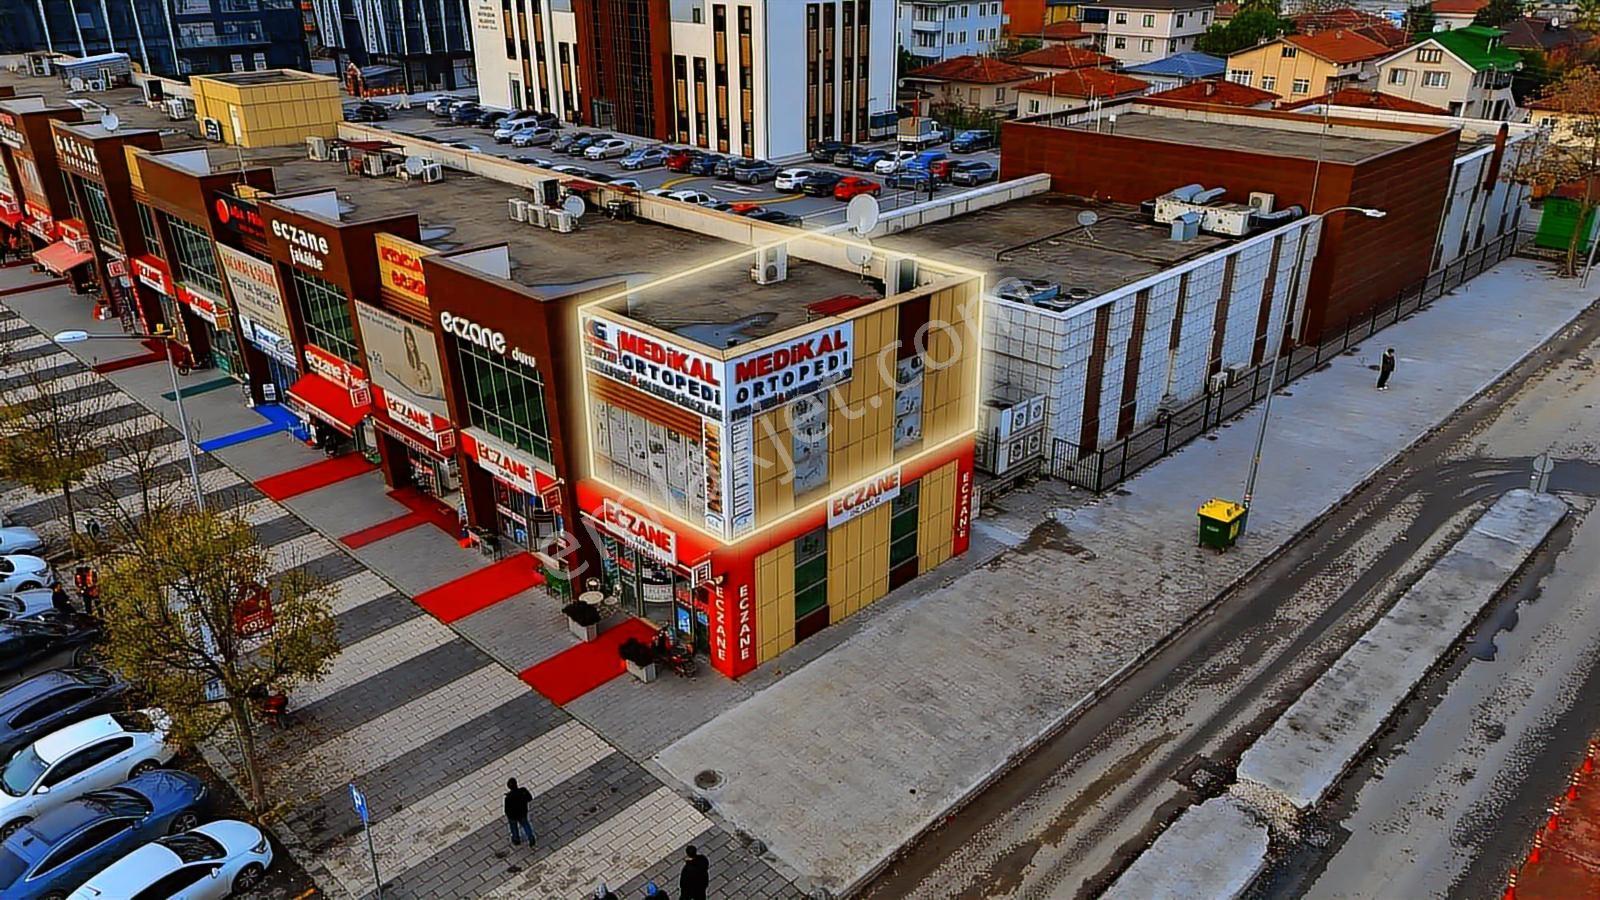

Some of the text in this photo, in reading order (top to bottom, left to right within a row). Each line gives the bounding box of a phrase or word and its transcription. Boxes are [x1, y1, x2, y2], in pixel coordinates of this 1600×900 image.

[272, 219, 329, 255] eczane
[441, 311, 536, 368] eczane duru
[479, 441, 532, 484] ECZANE
[832, 470, 899, 518] ECZANE
[605, 502, 672, 555] ECZANE
[715, 586, 727, 661] ECZANE
[739, 584, 751, 661] ECZANE
